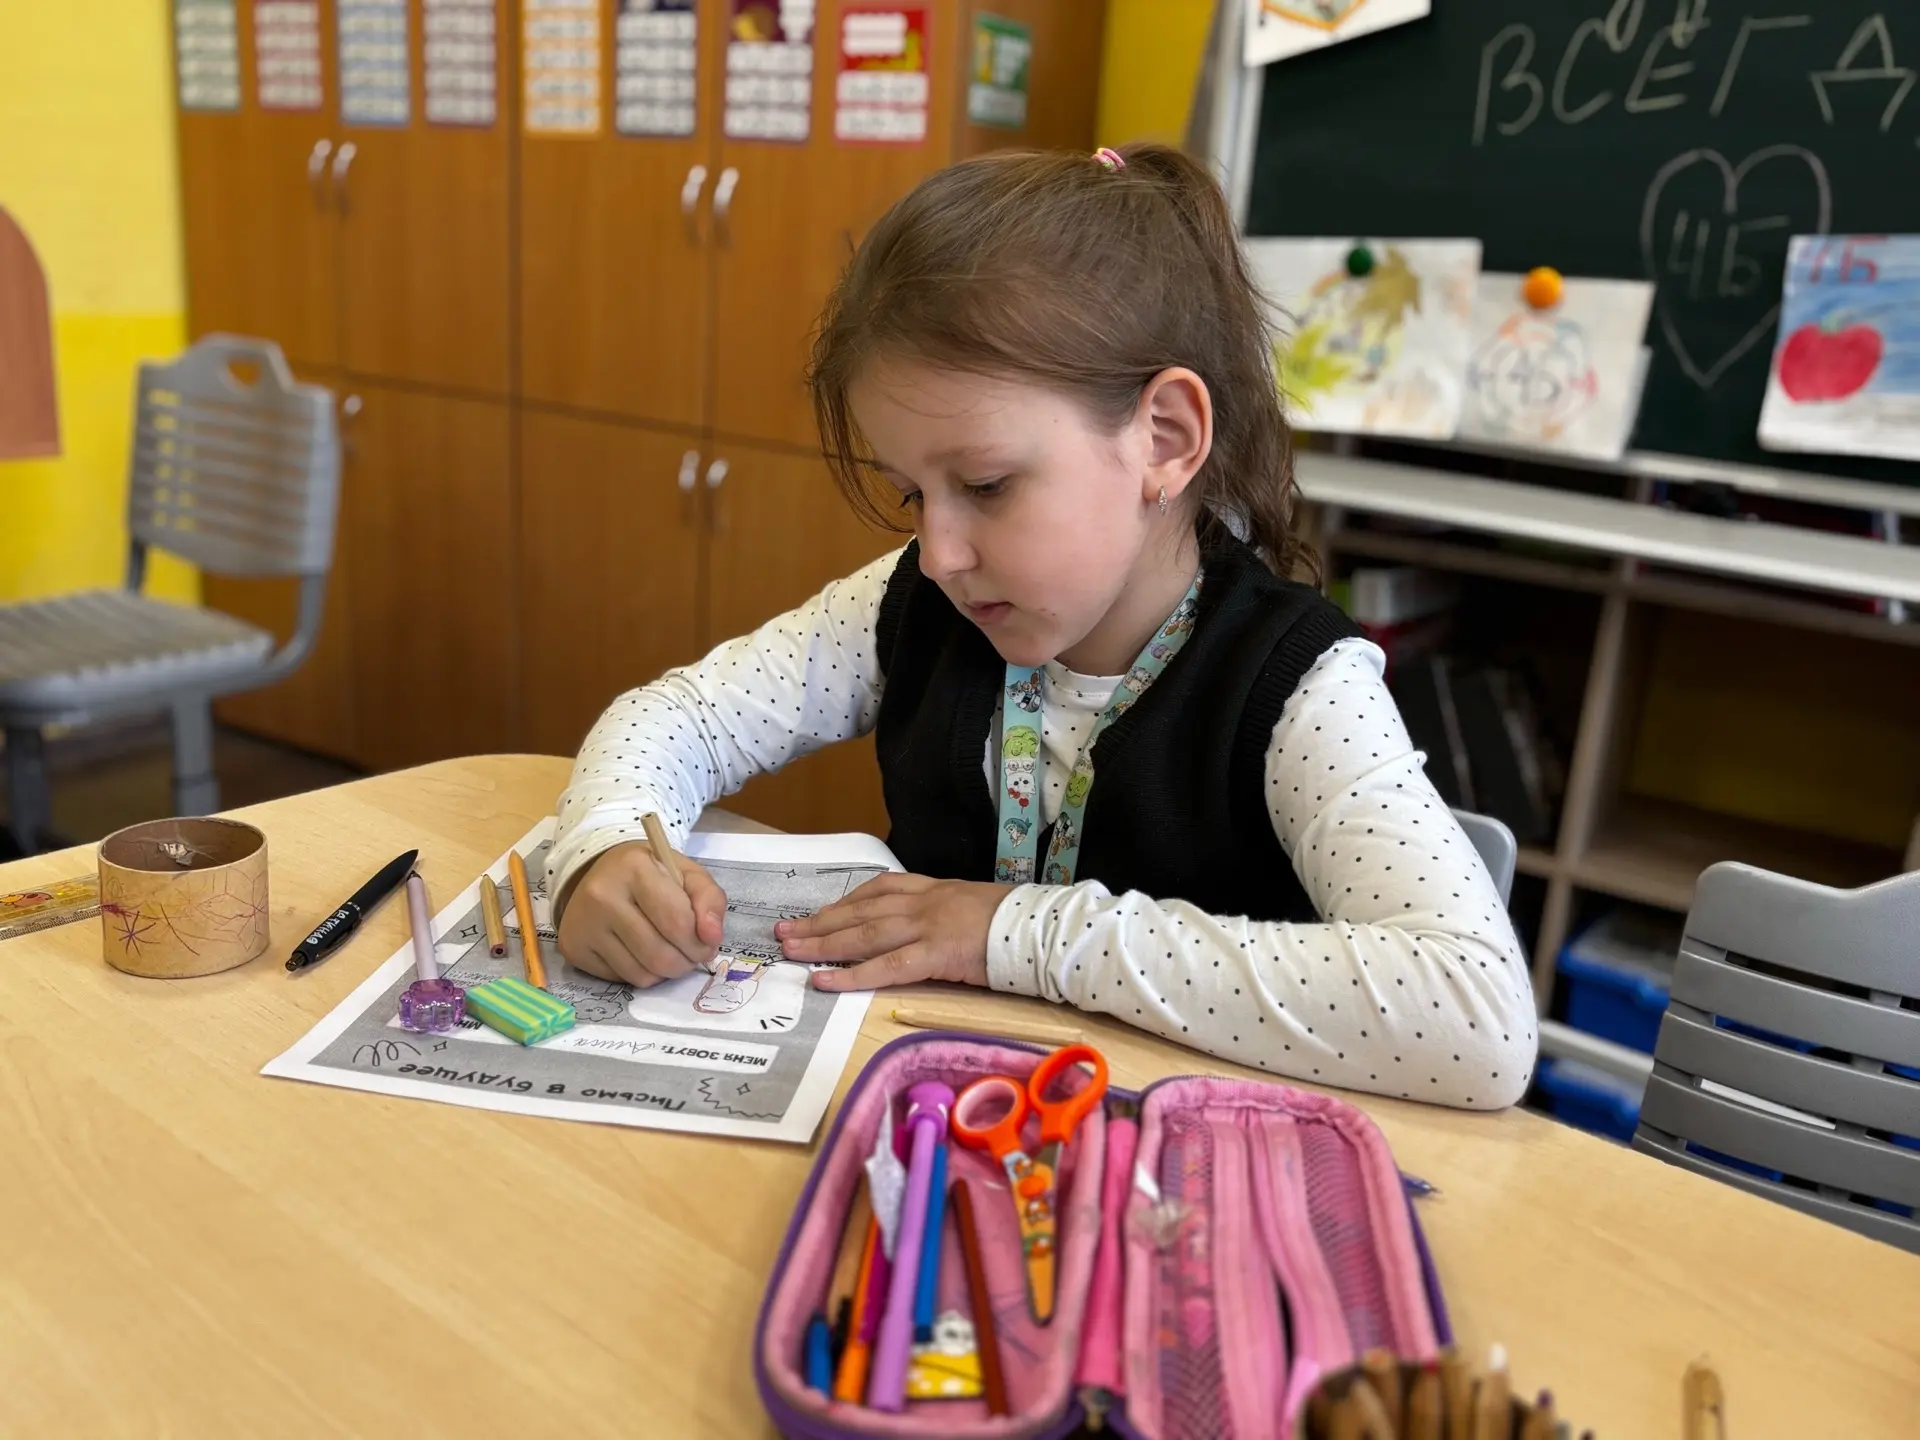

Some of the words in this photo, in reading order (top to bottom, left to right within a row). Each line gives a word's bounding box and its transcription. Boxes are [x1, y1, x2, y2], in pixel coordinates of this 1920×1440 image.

[660, 1044, 720, 1061] ЗОВУТ:
[723, 1053, 768, 1067] МЕНЯ
[397, 1062, 534, 1094] будущее
[548, 1083, 566, 1094] в
[580, 1087, 687, 1112] Письмо
